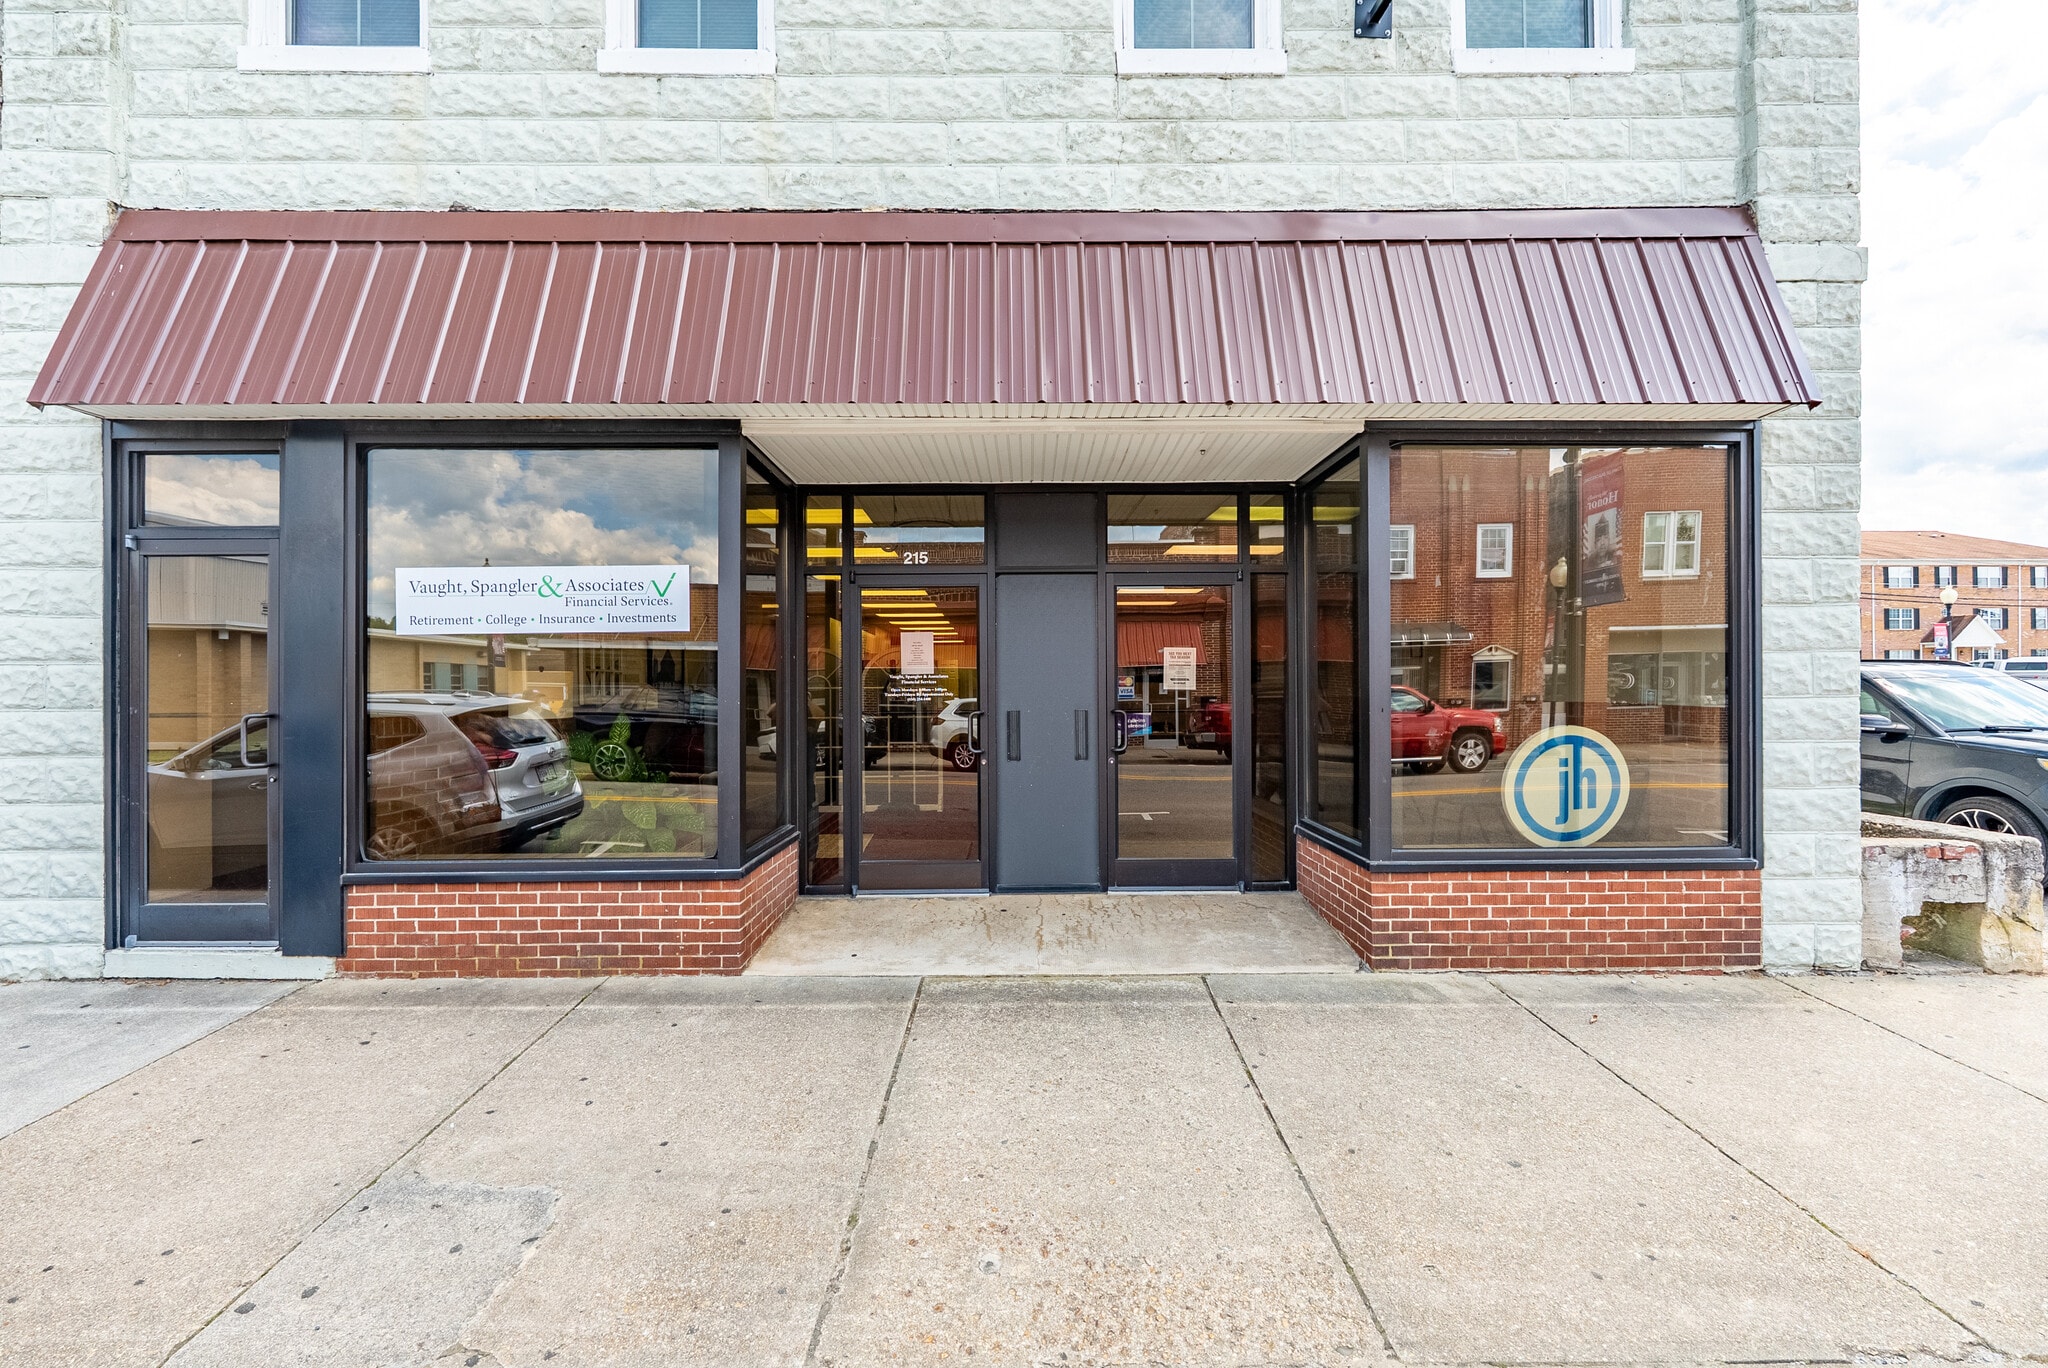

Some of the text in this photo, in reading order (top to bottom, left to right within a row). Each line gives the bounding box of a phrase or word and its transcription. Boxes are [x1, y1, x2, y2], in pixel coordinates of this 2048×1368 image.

[903, 552, 928, 564] 215
[409, 574, 645, 598] Vaught, Spangler & Associates
[565, 596, 617, 608] Financial
[409, 613, 677, 627] Retirement College Insurance Investments
